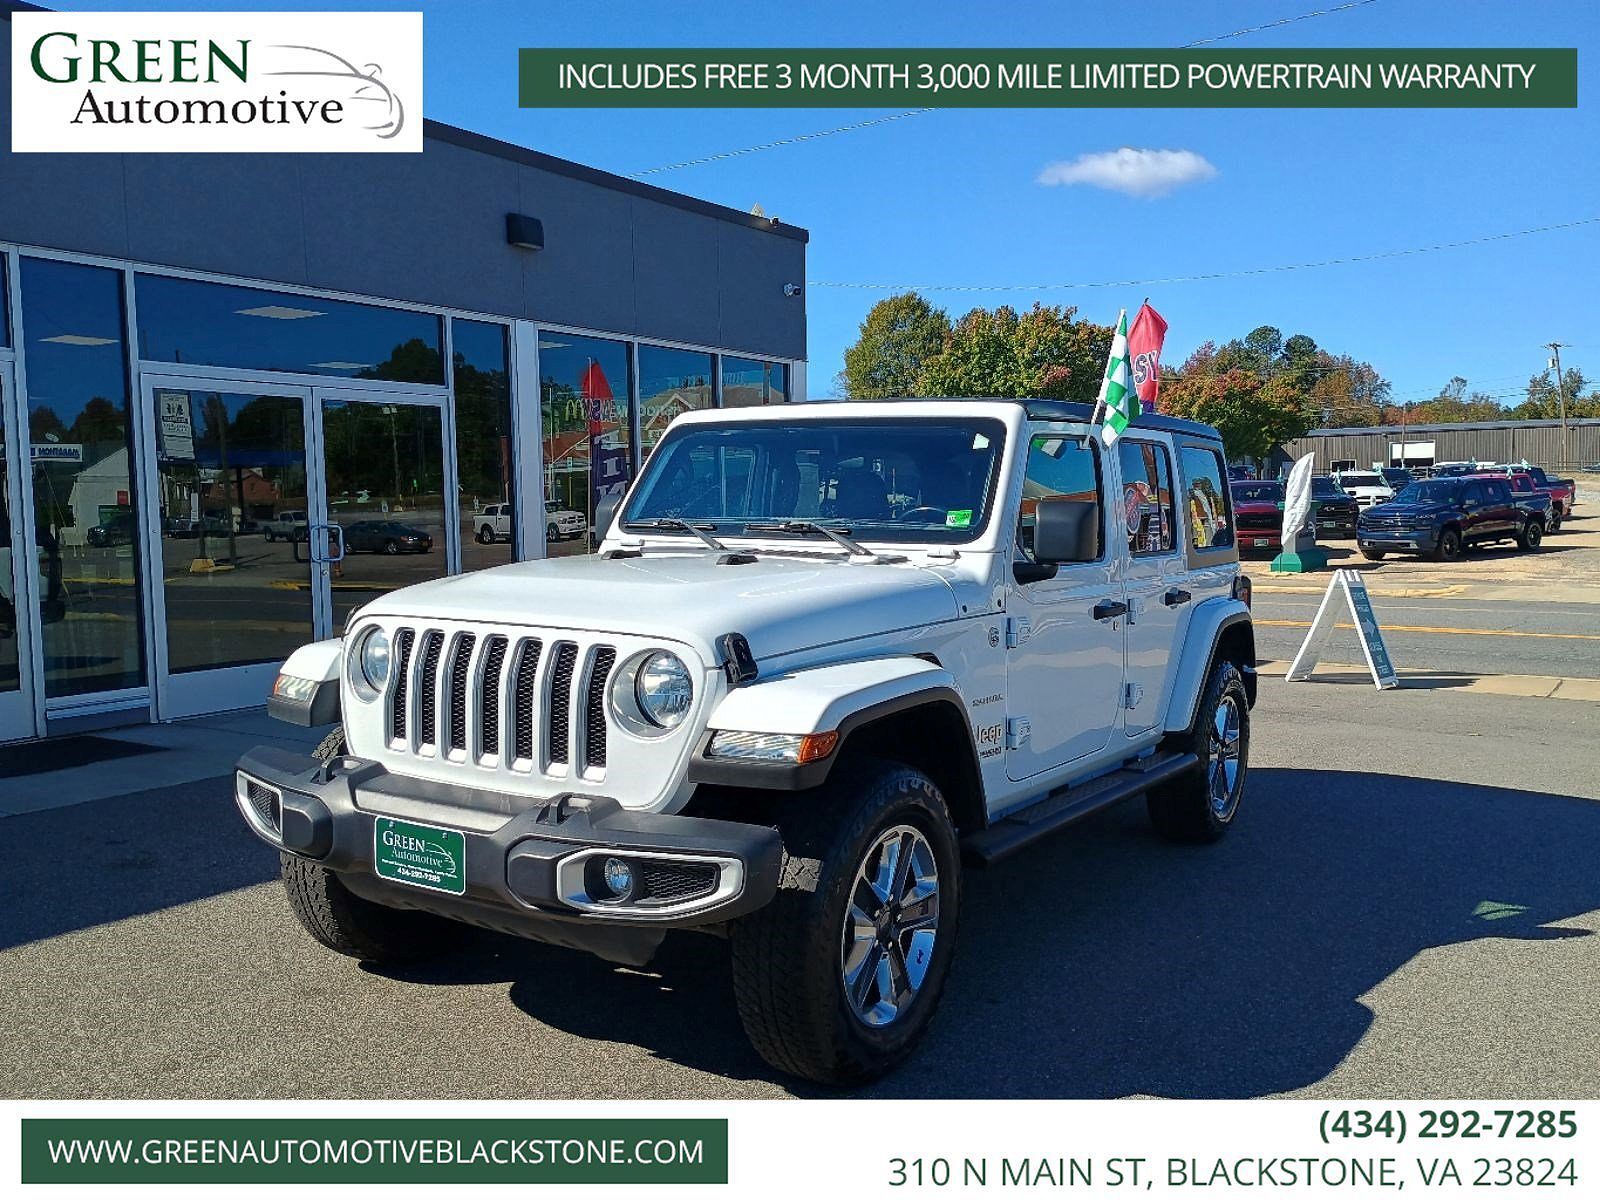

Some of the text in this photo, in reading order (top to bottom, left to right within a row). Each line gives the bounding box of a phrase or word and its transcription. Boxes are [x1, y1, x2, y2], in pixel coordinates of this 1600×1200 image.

[976, 724, 1001, 744] Jeep
[382, 830, 425, 852] GREEN
[391, 846, 443, 868] Automotive
